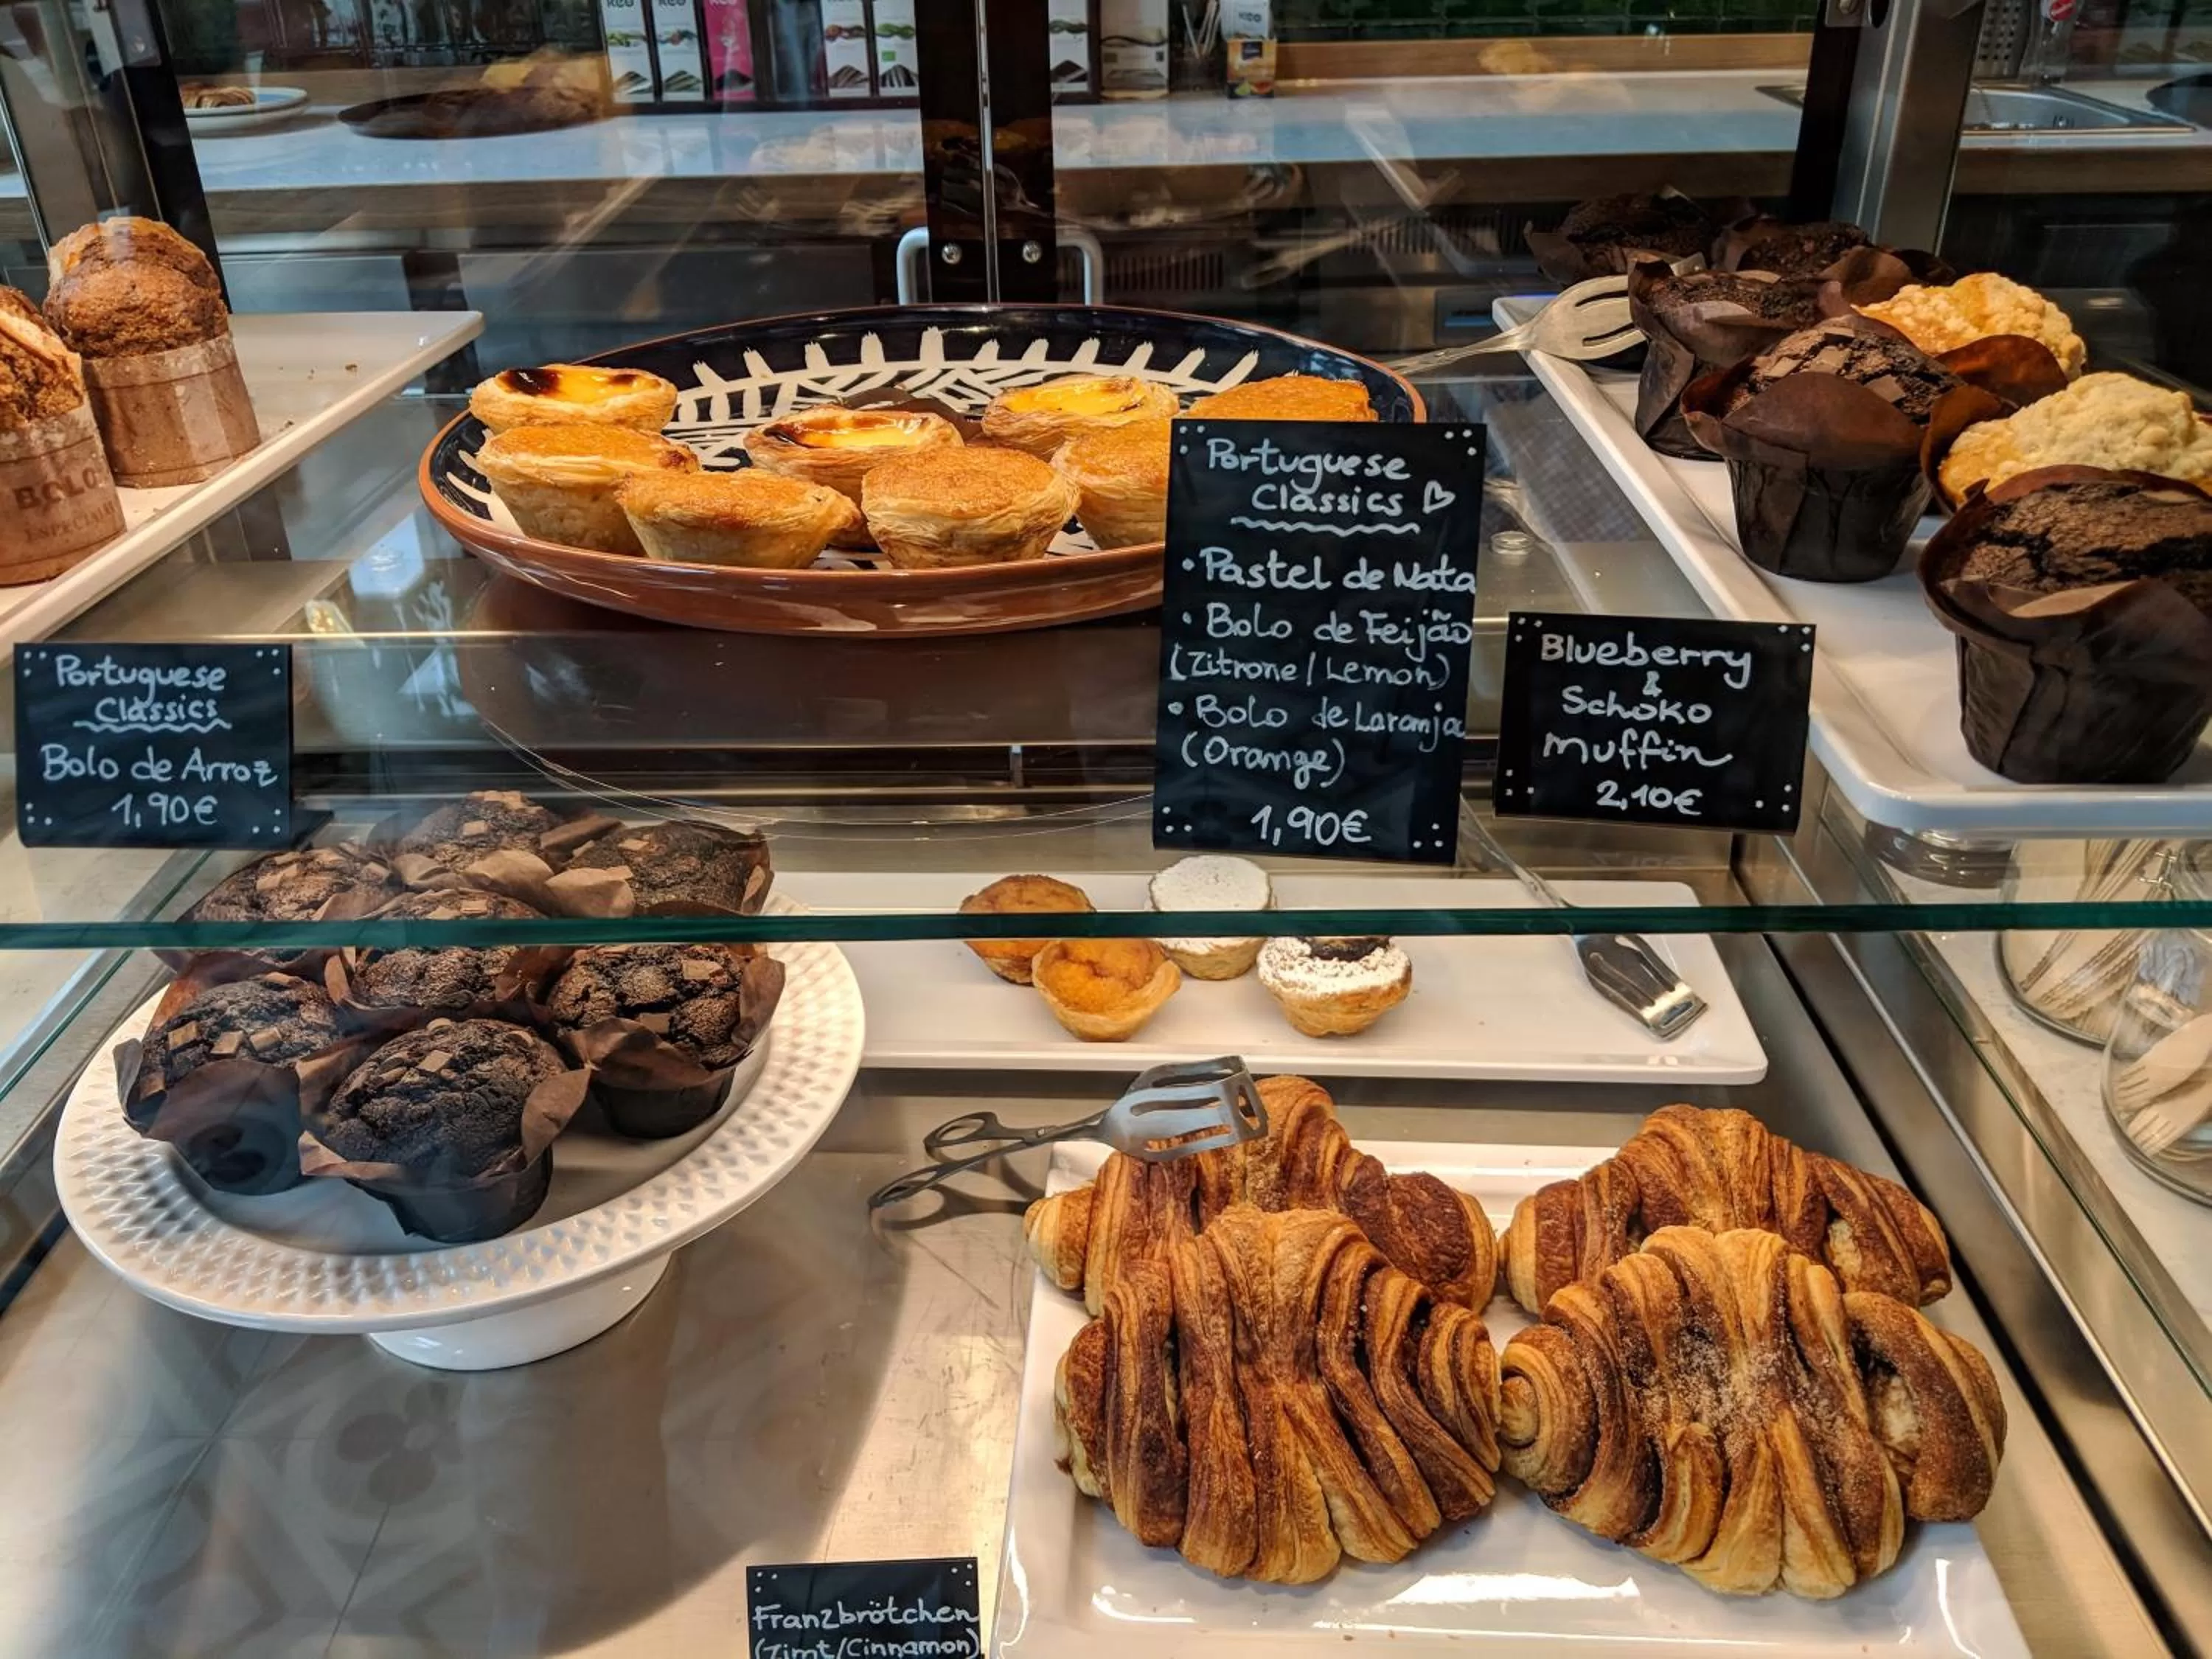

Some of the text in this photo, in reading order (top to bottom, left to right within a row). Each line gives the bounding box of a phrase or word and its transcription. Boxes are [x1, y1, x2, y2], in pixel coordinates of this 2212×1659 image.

[1206, 438, 1411, 495] Portuguese
[1251, 486, 1404, 515] Classics
[1199, 547, 1476, 594] Pastel de Nata
[1206, 602, 1472, 661] Bolo de Feijão
[55, 655, 226, 706] Portuguese
[1540, 631, 1752, 689] Blueberry
[1562, 685, 1712, 724] Schoko
[1642, 671, 1662, 697] &
[95, 695, 219, 723] Classics
[1195, 695, 1465, 753] Bolo de Laranja
[41, 743, 278, 787] Bolo de Arroz
[1180, 731, 1346, 790] (Orange)
[111, 792, 218, 829] 1,90€
[1250, 805, 1372, 846] 1,90€
[752, 1596, 978, 1630] Franzbrötchen
